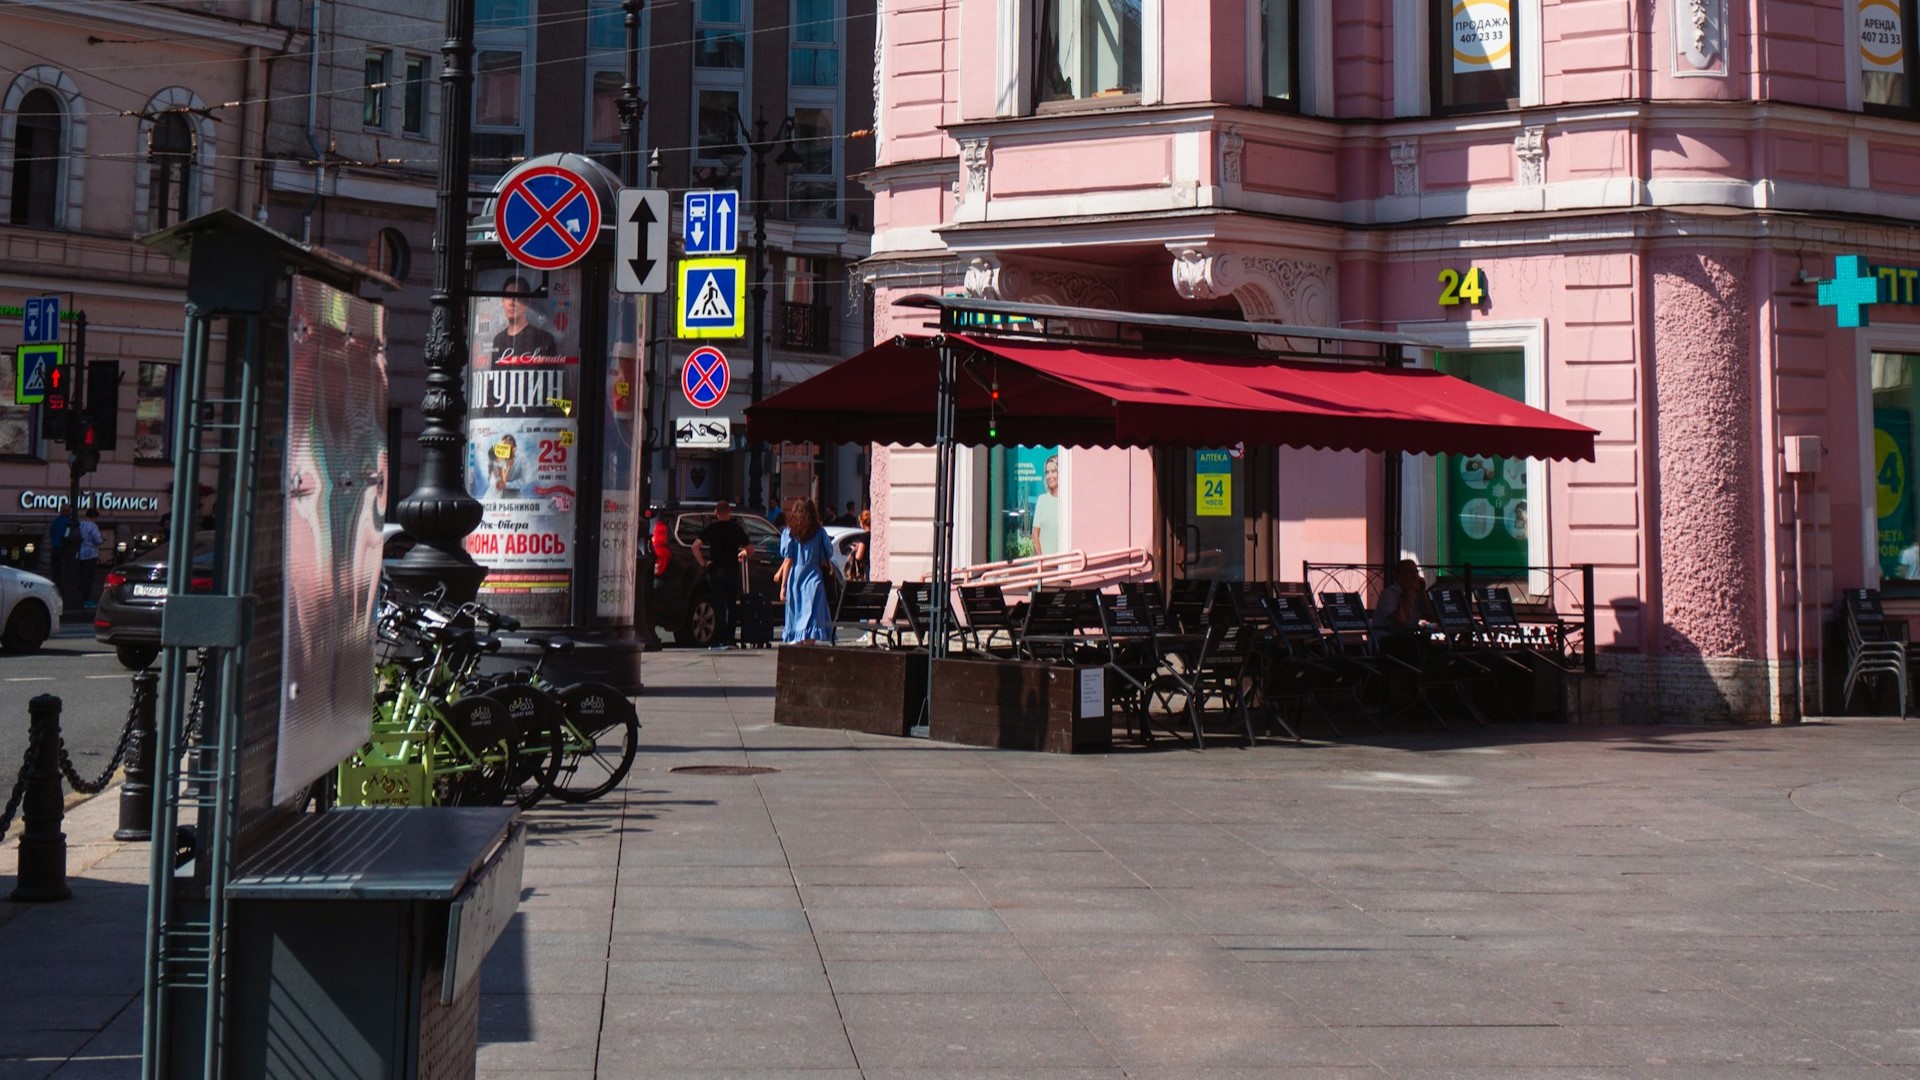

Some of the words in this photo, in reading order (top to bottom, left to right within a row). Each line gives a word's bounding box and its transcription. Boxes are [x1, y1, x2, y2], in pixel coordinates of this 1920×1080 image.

[1455, 17, 1509, 32] ПРОДАЖА
[1864, 18, 1897, 32] АРЕНДА
[1460, 33, 1477, 43] 407
[1479, 32, 1490, 42] 23
[1492, 30, 1503, 41] 33
[1861, 31, 1876, 42] 407
[1878, 32, 1889, 44] 23
[1890, 33, 1901, 45] 33
[1438, 267, 1483, 305] 24
[1867, 266, 1919, 303] ПТ
[539, 439, 568, 464] 25
[1200, 453, 1228, 462] АПТЕКА
[538, 464, 568, 472] АВГУСТА
[1878, 452, 1901, 494] 4
[1205, 480, 1224, 498] 24
[94, 491, 158, 511] Тбилиси
[499, 503, 540, 512] РЫБНИКОВ
[505, 533, 566, 555] АВОСЬ
